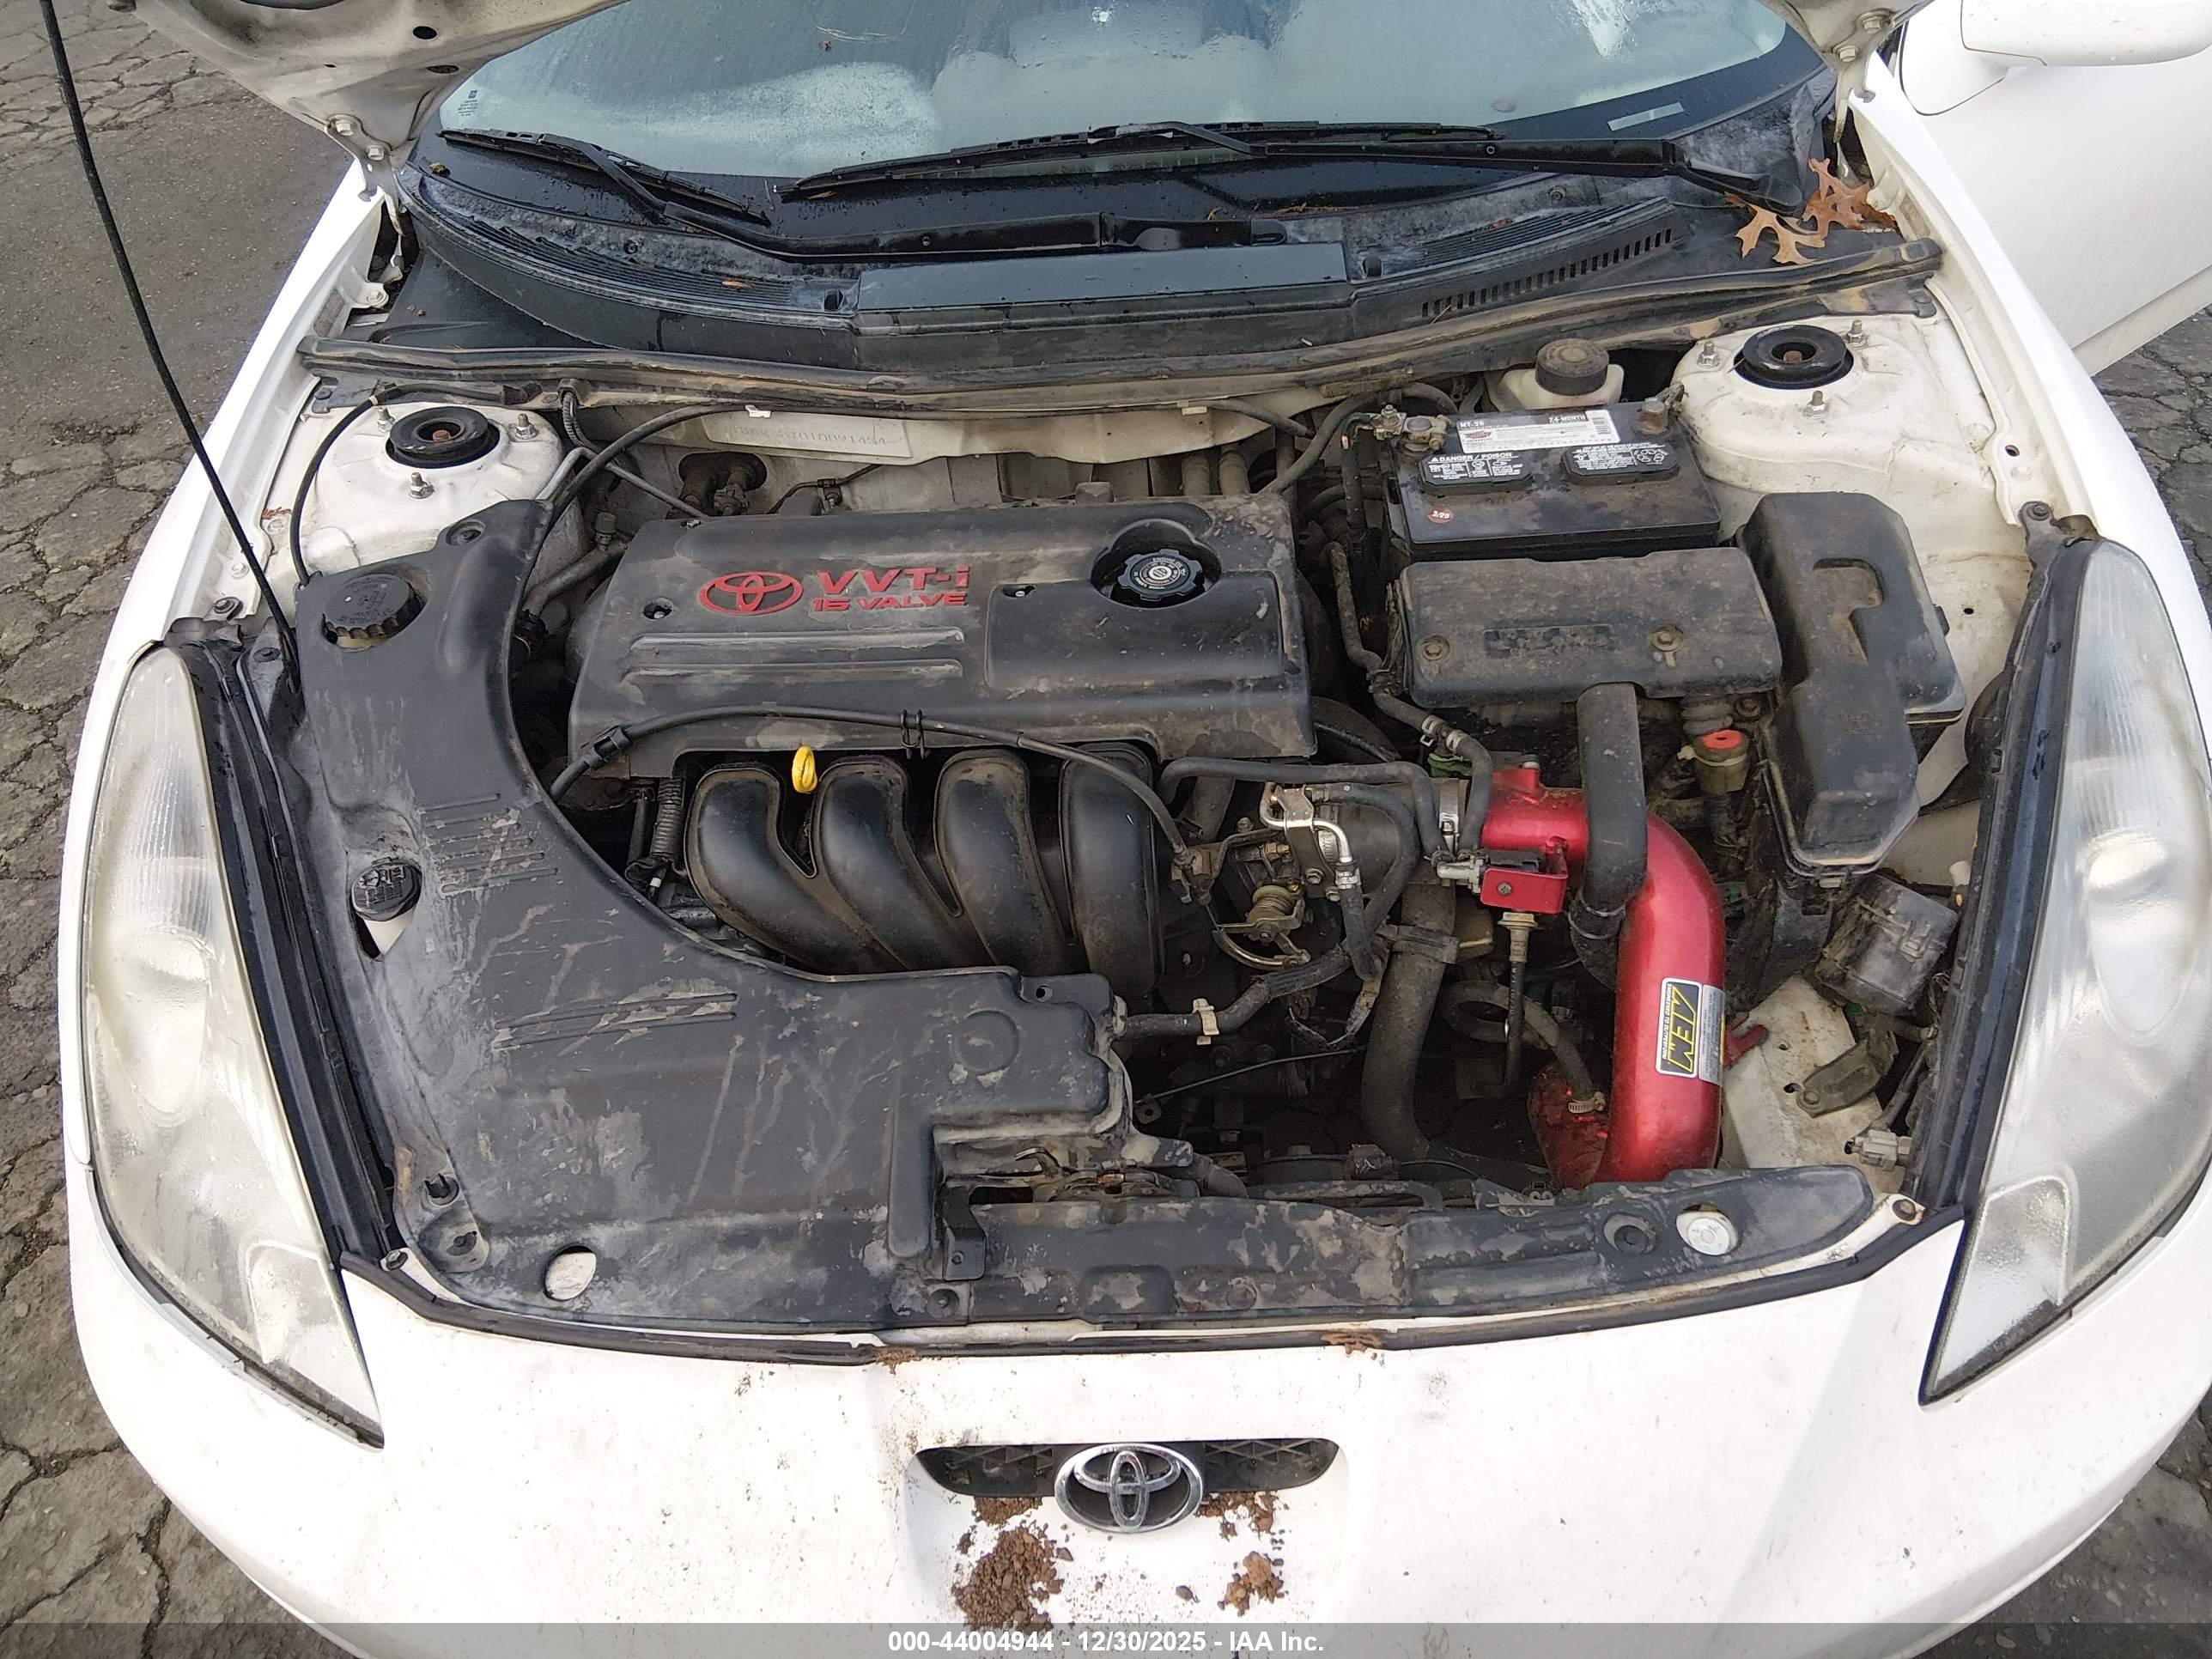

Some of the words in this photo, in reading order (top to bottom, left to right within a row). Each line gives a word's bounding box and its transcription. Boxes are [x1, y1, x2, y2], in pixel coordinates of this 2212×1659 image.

[817, 565, 970, 594] VVT-i
[813, 598, 850, 612] 16
[857, 591, 967, 611] VALVE
[1667, 985, 1696, 1073] AEM
